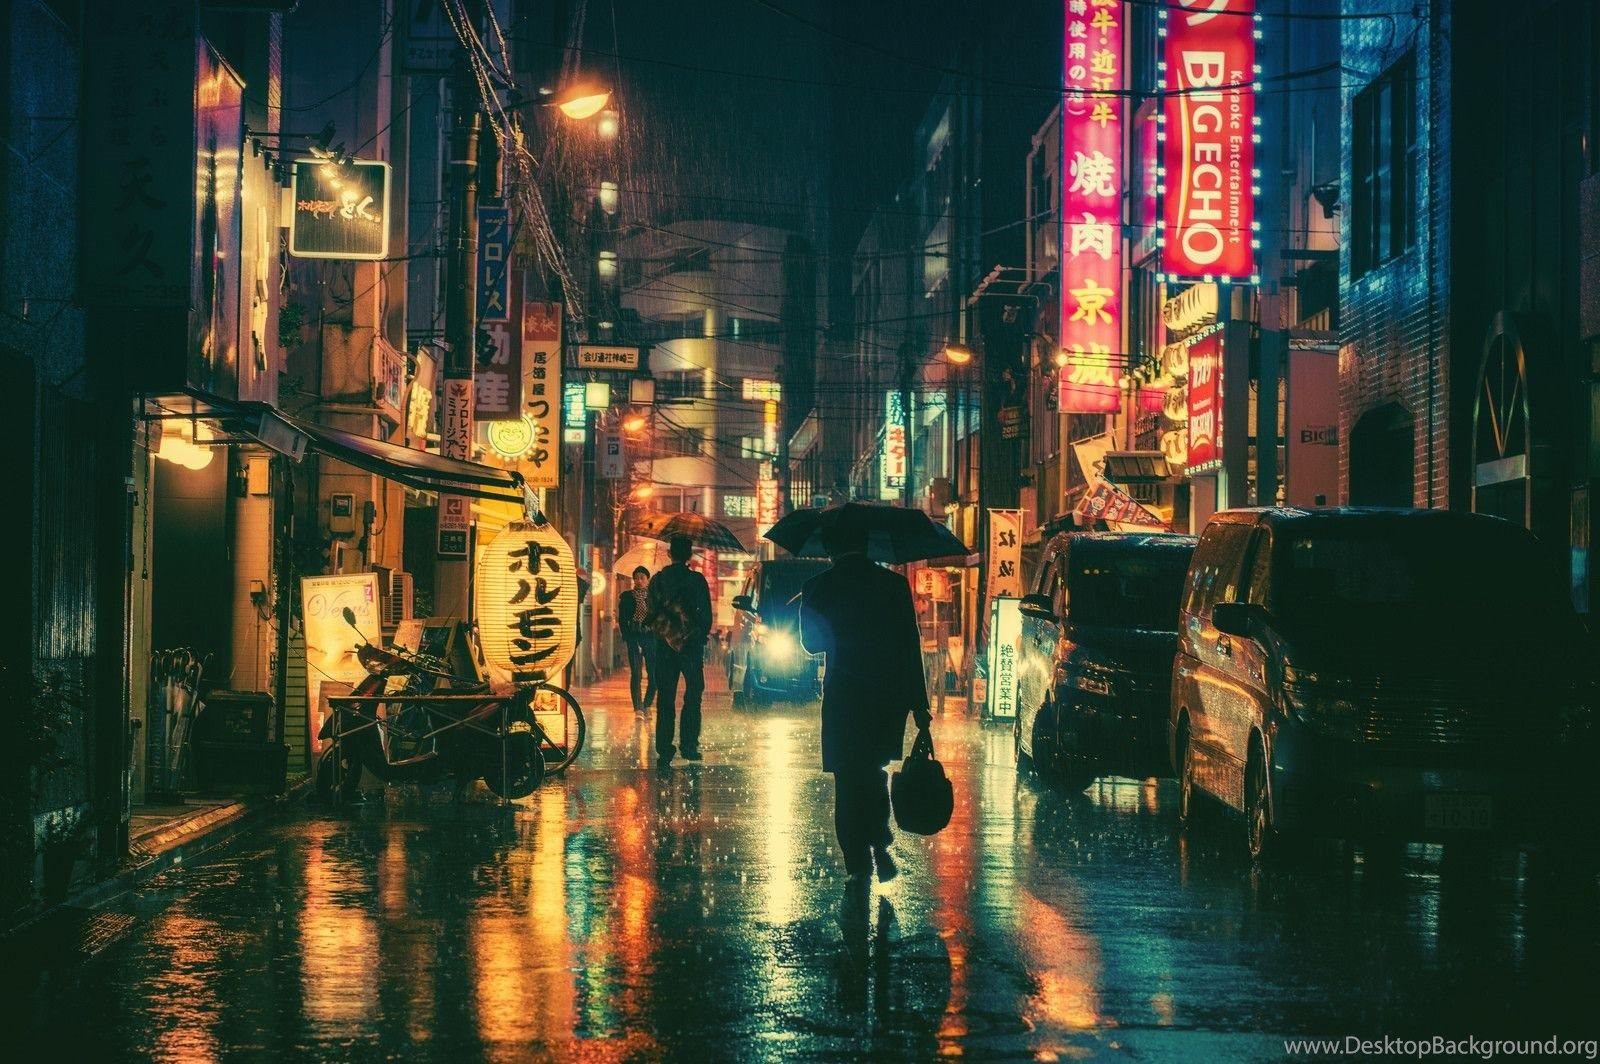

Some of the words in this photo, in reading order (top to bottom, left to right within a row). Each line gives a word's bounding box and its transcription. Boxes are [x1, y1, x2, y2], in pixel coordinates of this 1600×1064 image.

[1230, 71, 1243, 129] Karaoke
[1230, 136, 1243, 244] Entertainment
[485, 216, 506, 311] プロレス
[507, 541, 562, 666] ホルモン
[1000, 644, 1014, 715] 絶賛営業中
